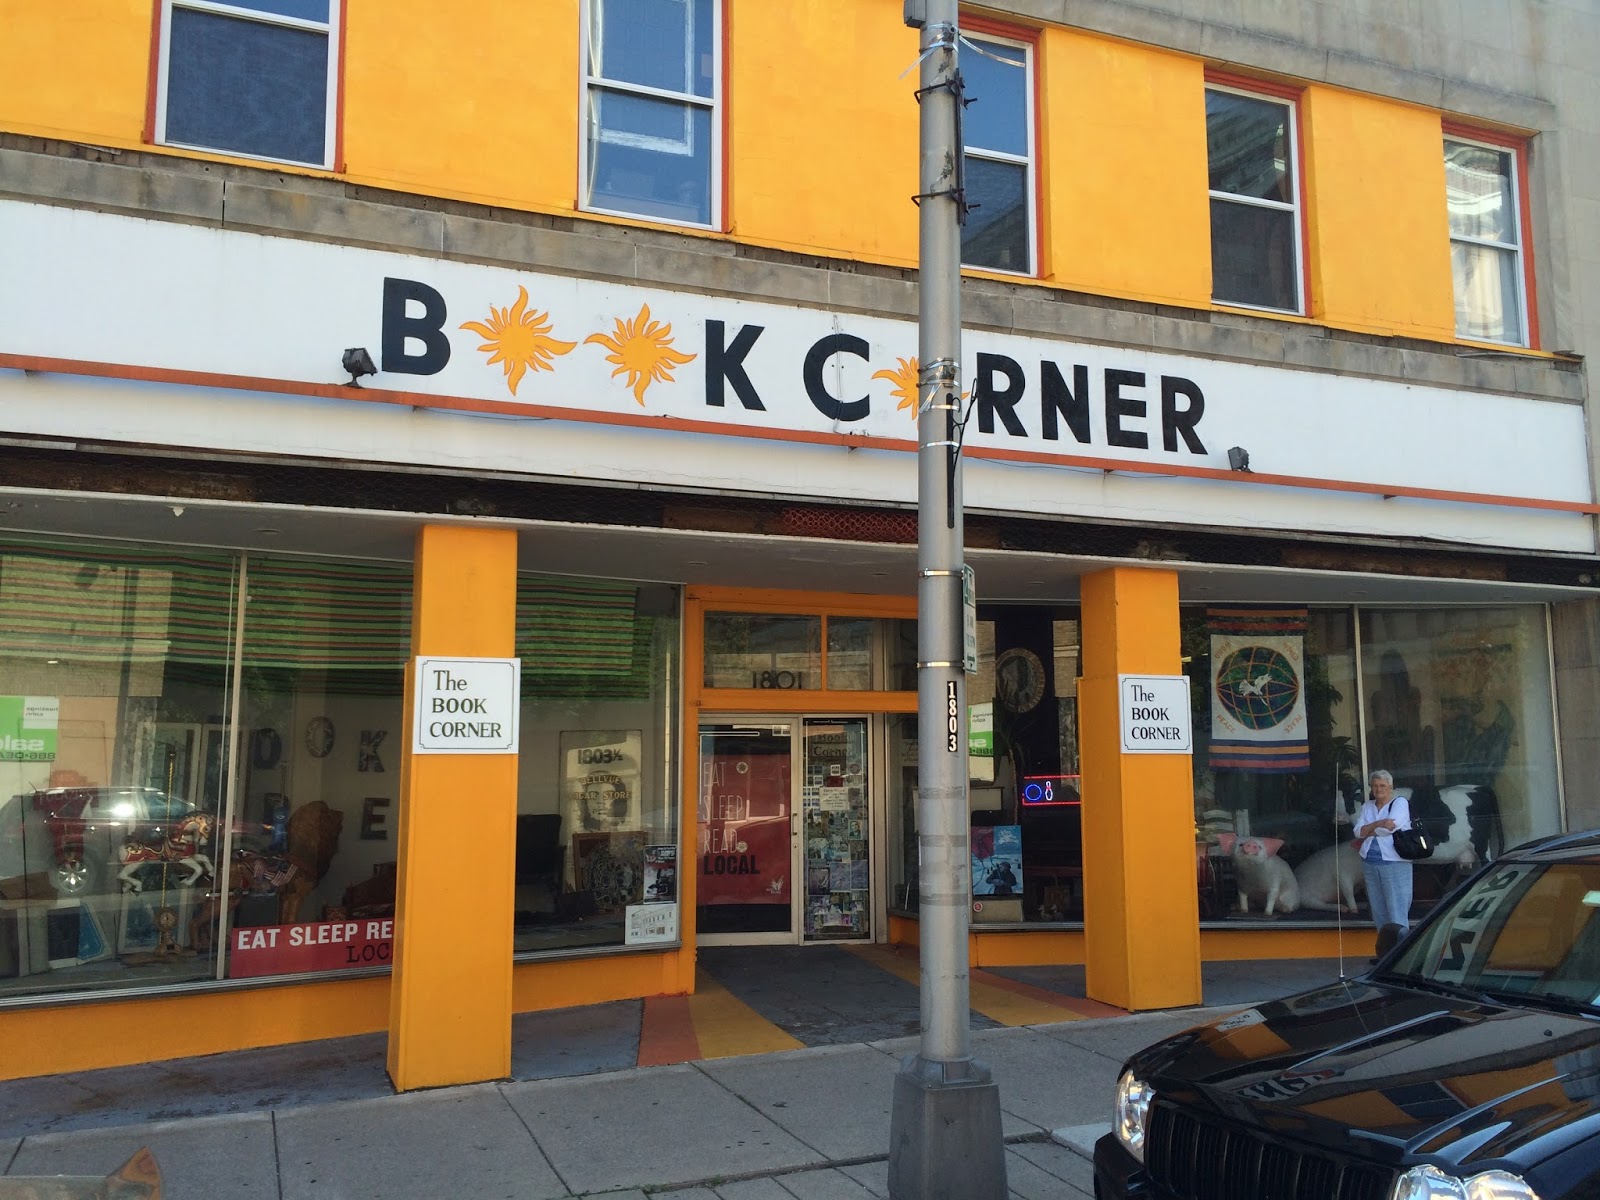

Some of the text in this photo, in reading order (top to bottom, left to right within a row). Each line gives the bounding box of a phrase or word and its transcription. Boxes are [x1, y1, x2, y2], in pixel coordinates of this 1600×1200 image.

[433, 670, 468, 691] The
[752, 670, 802, 689] 1801
[1131, 684, 1155, 702] The
[432, 698, 487, 714] BOOK
[1131, 707, 1170, 721] BOOK
[948, 682, 957, 752] 1803
[1216, 714, 1236, 734] PEACE
[429, 721, 502, 738] CORNER
[1131, 726, 1181, 740] CORNER
[704, 762, 726, 787] EAT
[703, 795, 743, 820] SLEEP
[703, 828, 738, 854] READ
[704, 855, 760, 875] LOCAL
[238, 920, 394, 950] EAT SLEEP RE
